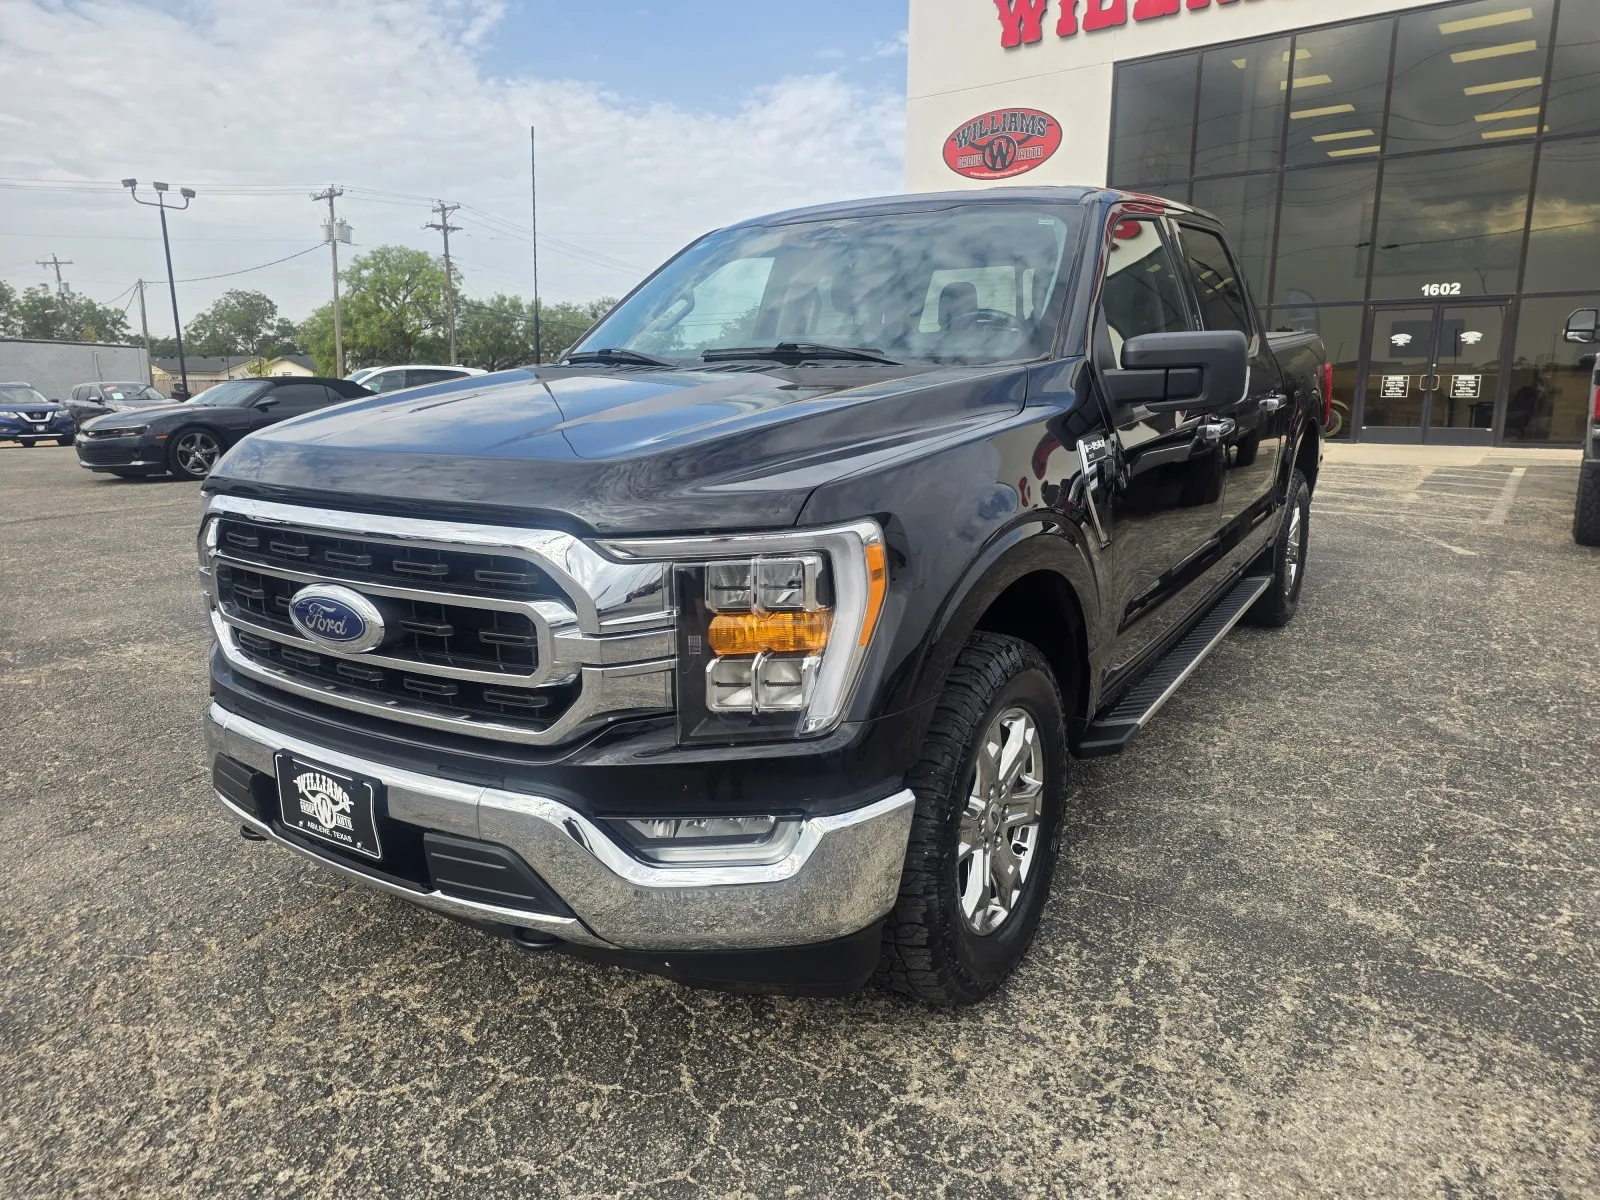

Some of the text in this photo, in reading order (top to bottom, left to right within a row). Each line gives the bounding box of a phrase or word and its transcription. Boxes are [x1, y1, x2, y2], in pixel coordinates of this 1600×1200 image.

[955, 112, 1048, 150] WILLIAMS
[957, 154, 983, 169] GROUP
[1018, 145, 1043, 161] AUTO
[1421, 282, 1461, 296] 1602
[305, 603, 347, 635] Ford
[296, 772, 351, 813] WILLIAMS
[333, 830, 352, 842] TEXAS
